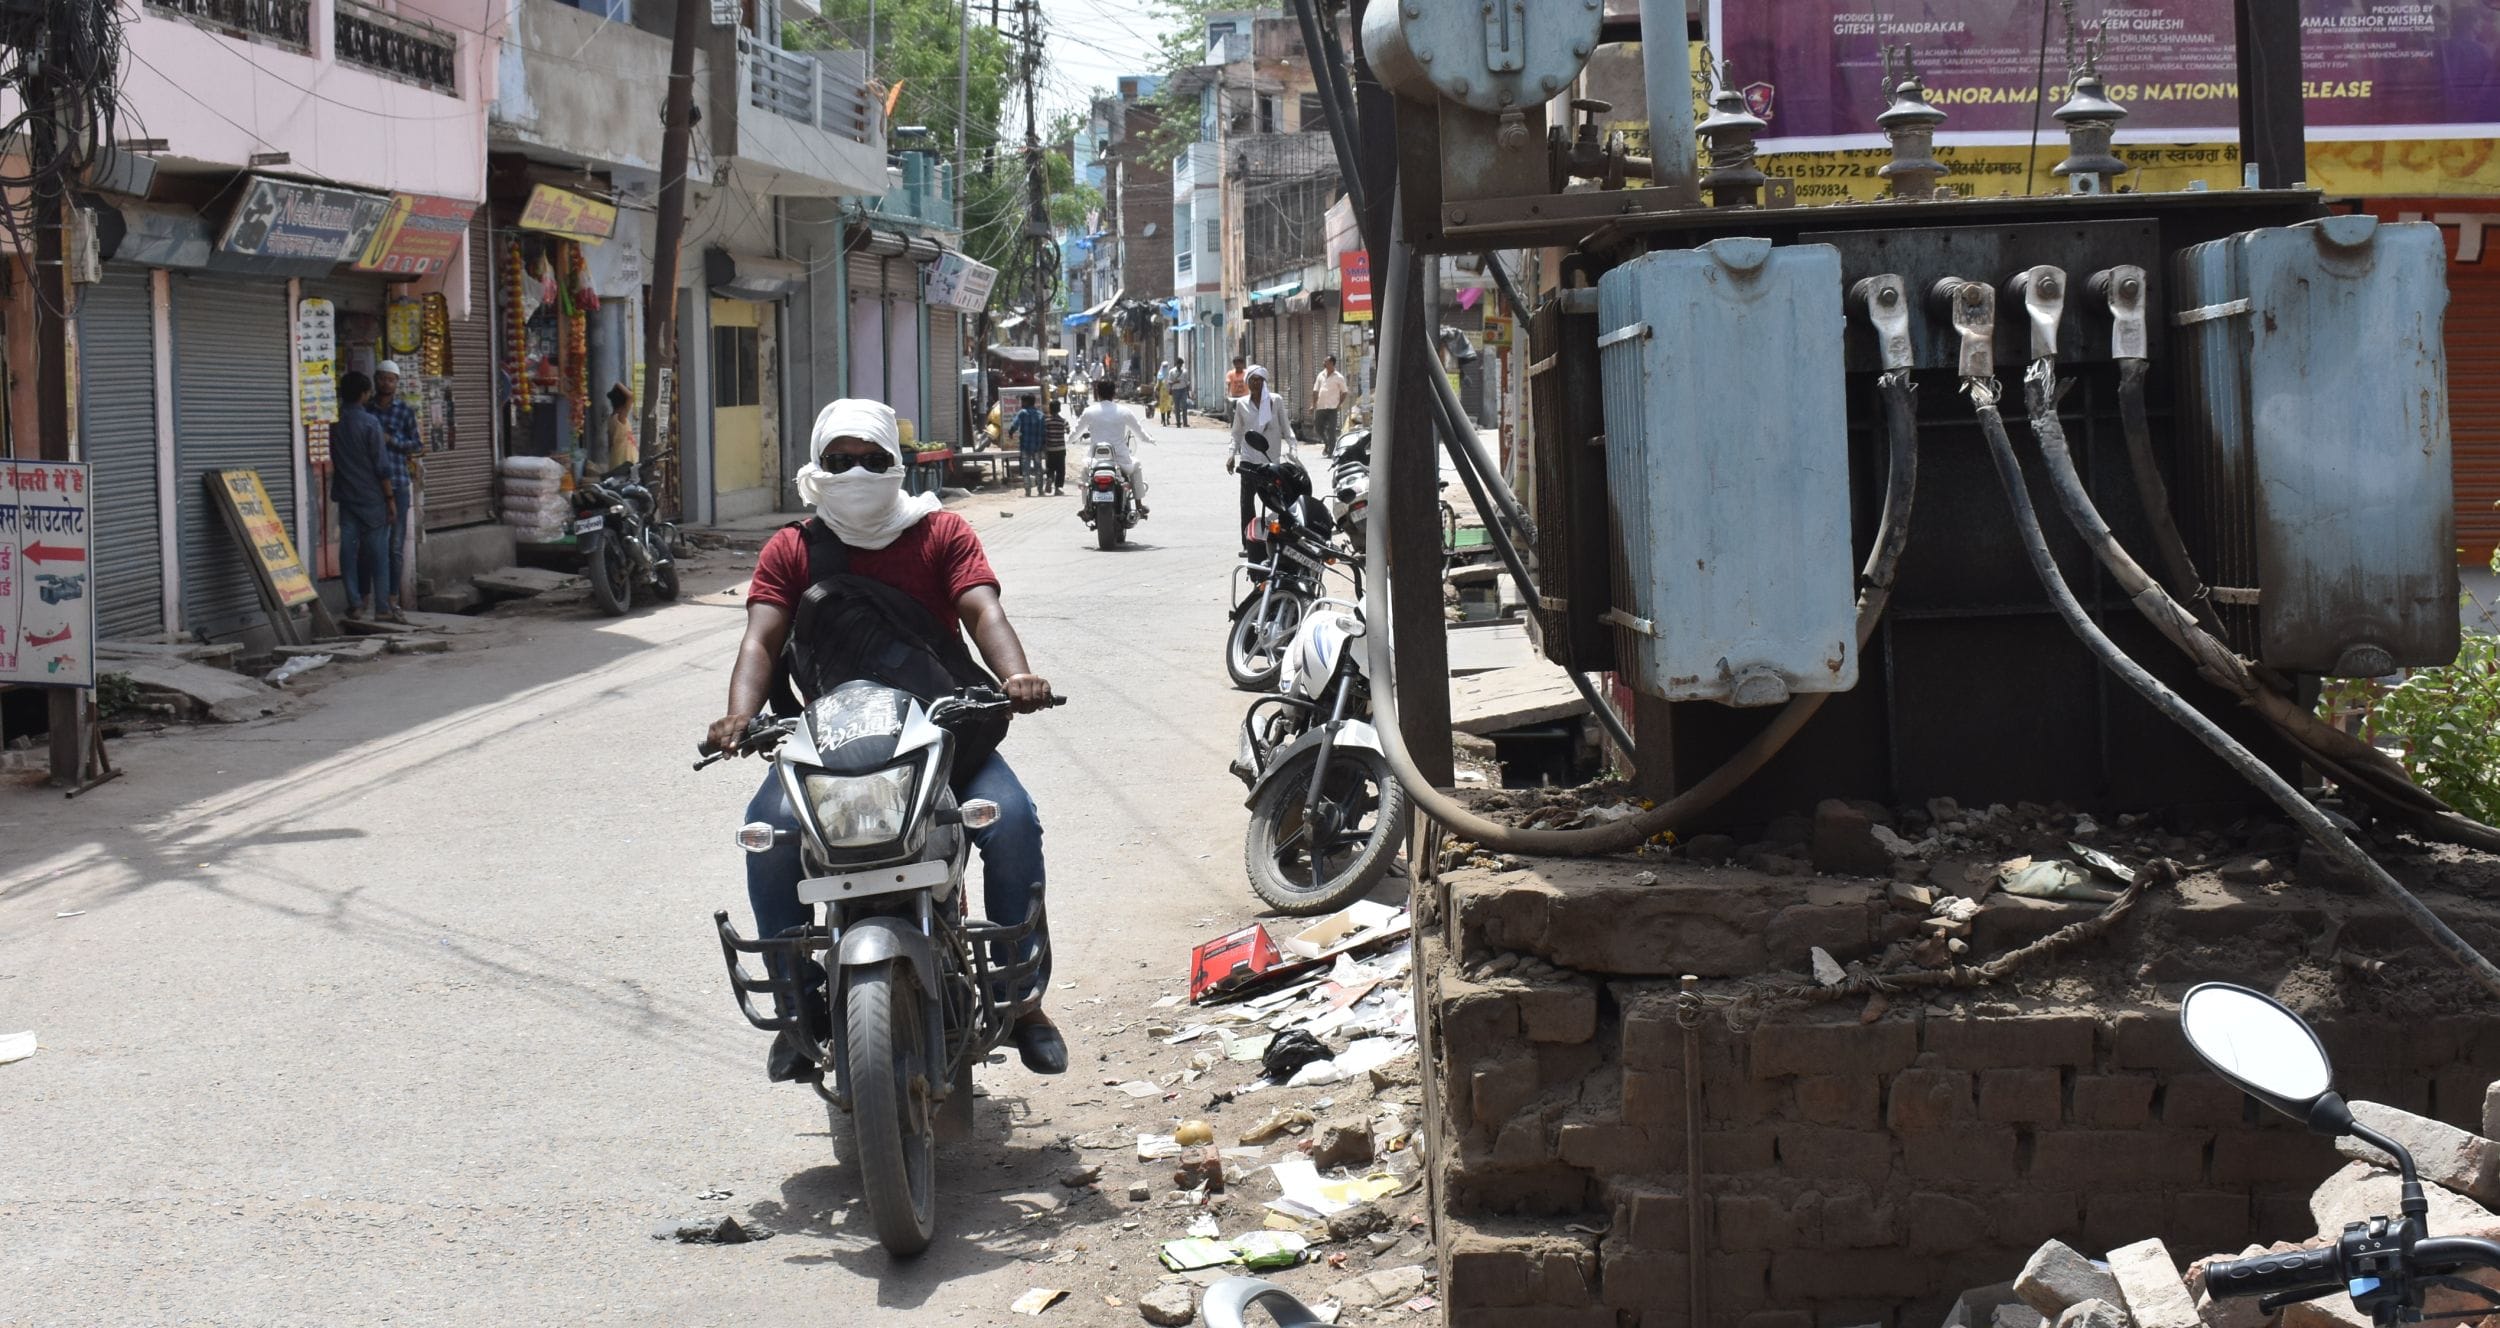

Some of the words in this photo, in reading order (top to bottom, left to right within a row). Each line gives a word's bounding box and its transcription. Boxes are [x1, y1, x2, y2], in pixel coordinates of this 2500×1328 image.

[2102, 9, 2150, 17] PRODUCED
[2152, 8, 2163, 17] BY
[2371, 5, 2421, 14] PRODUCED
[2422, 4, 2434, 13] BY
[1883, 13, 1894, 22] BY
[2081, 19, 2129, 30] VAEEM
[2132, 18, 2184, 30] QURESHI
[2300, 16, 2336, 28] AMAL
[2339, 15, 2384, 27] KISHOR
[2387, 14, 2435, 26] MISHRA
[1833, 23, 1875, 35] GITESH
[1879, 21, 1965, 35] CHANDRAKAR
[2120, 33, 2158, 43] DRUMS
[2160, 33, 2215, 43] SHIVAMANI
[1921, 87, 2040, 105] PANORAMA
[2048, 83, 2139, 102] STIOS
[2144, 82, 2239, 101] NATIONW
[2302, 80, 2373, 99] ELEASE
[2126, 149, 2161, 165] कदम
[1795, 183, 1849, 197] 05979834
[277, 189, 361, 229] Neelkamal
[1346, 267, 1370, 276] SMA
[7, 466, 48, 492] गैलरी
[53, 467, 68, 493] में
[70, 468, 84, 494] है
[23, 495, 85, 536] आउटलेट
